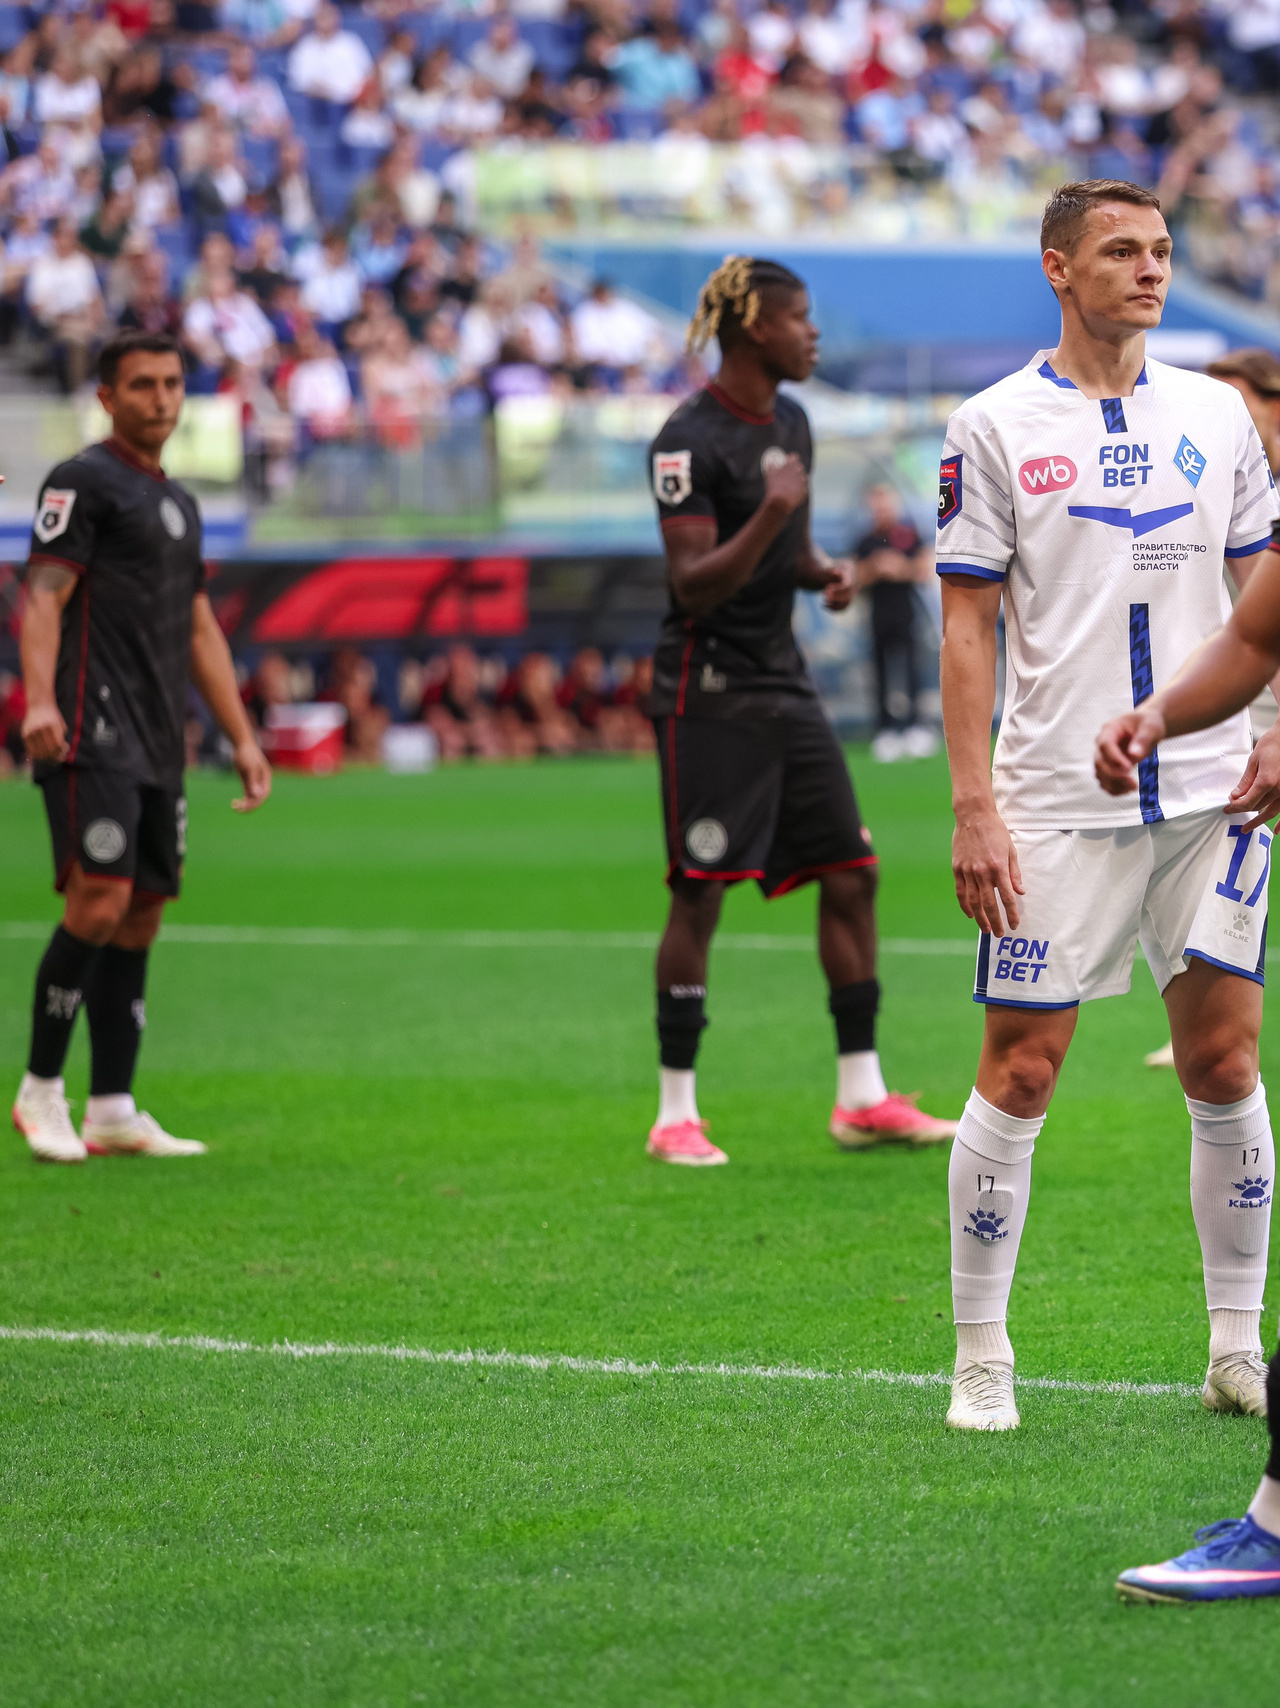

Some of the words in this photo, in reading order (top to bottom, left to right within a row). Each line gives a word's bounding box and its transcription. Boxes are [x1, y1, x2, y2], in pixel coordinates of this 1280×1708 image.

[1099, 444, 1149, 465] FON
[1023, 460, 1070, 488] wb
[1103, 465, 1153, 488] BET
[1132, 543, 1207, 553] ПРАВИТЕЛЬСТВО
[1132, 552, 1189, 561] САМАРСКОЙ
[1133, 563, 1179, 571] ОБЛАСТИ
[1215, 824, 1272, 908] 17
[1223, 928, 1250, 943] KELME
[997, 937, 1050, 961] FON
[995, 960, 1048, 984] BET
[1242, 1147, 1260, 1166] 17
[977, 1174, 995, 1194] 17
[1228, 1195, 1271, 1209] KELME
[963, 1225, 1009, 1241] KELME
